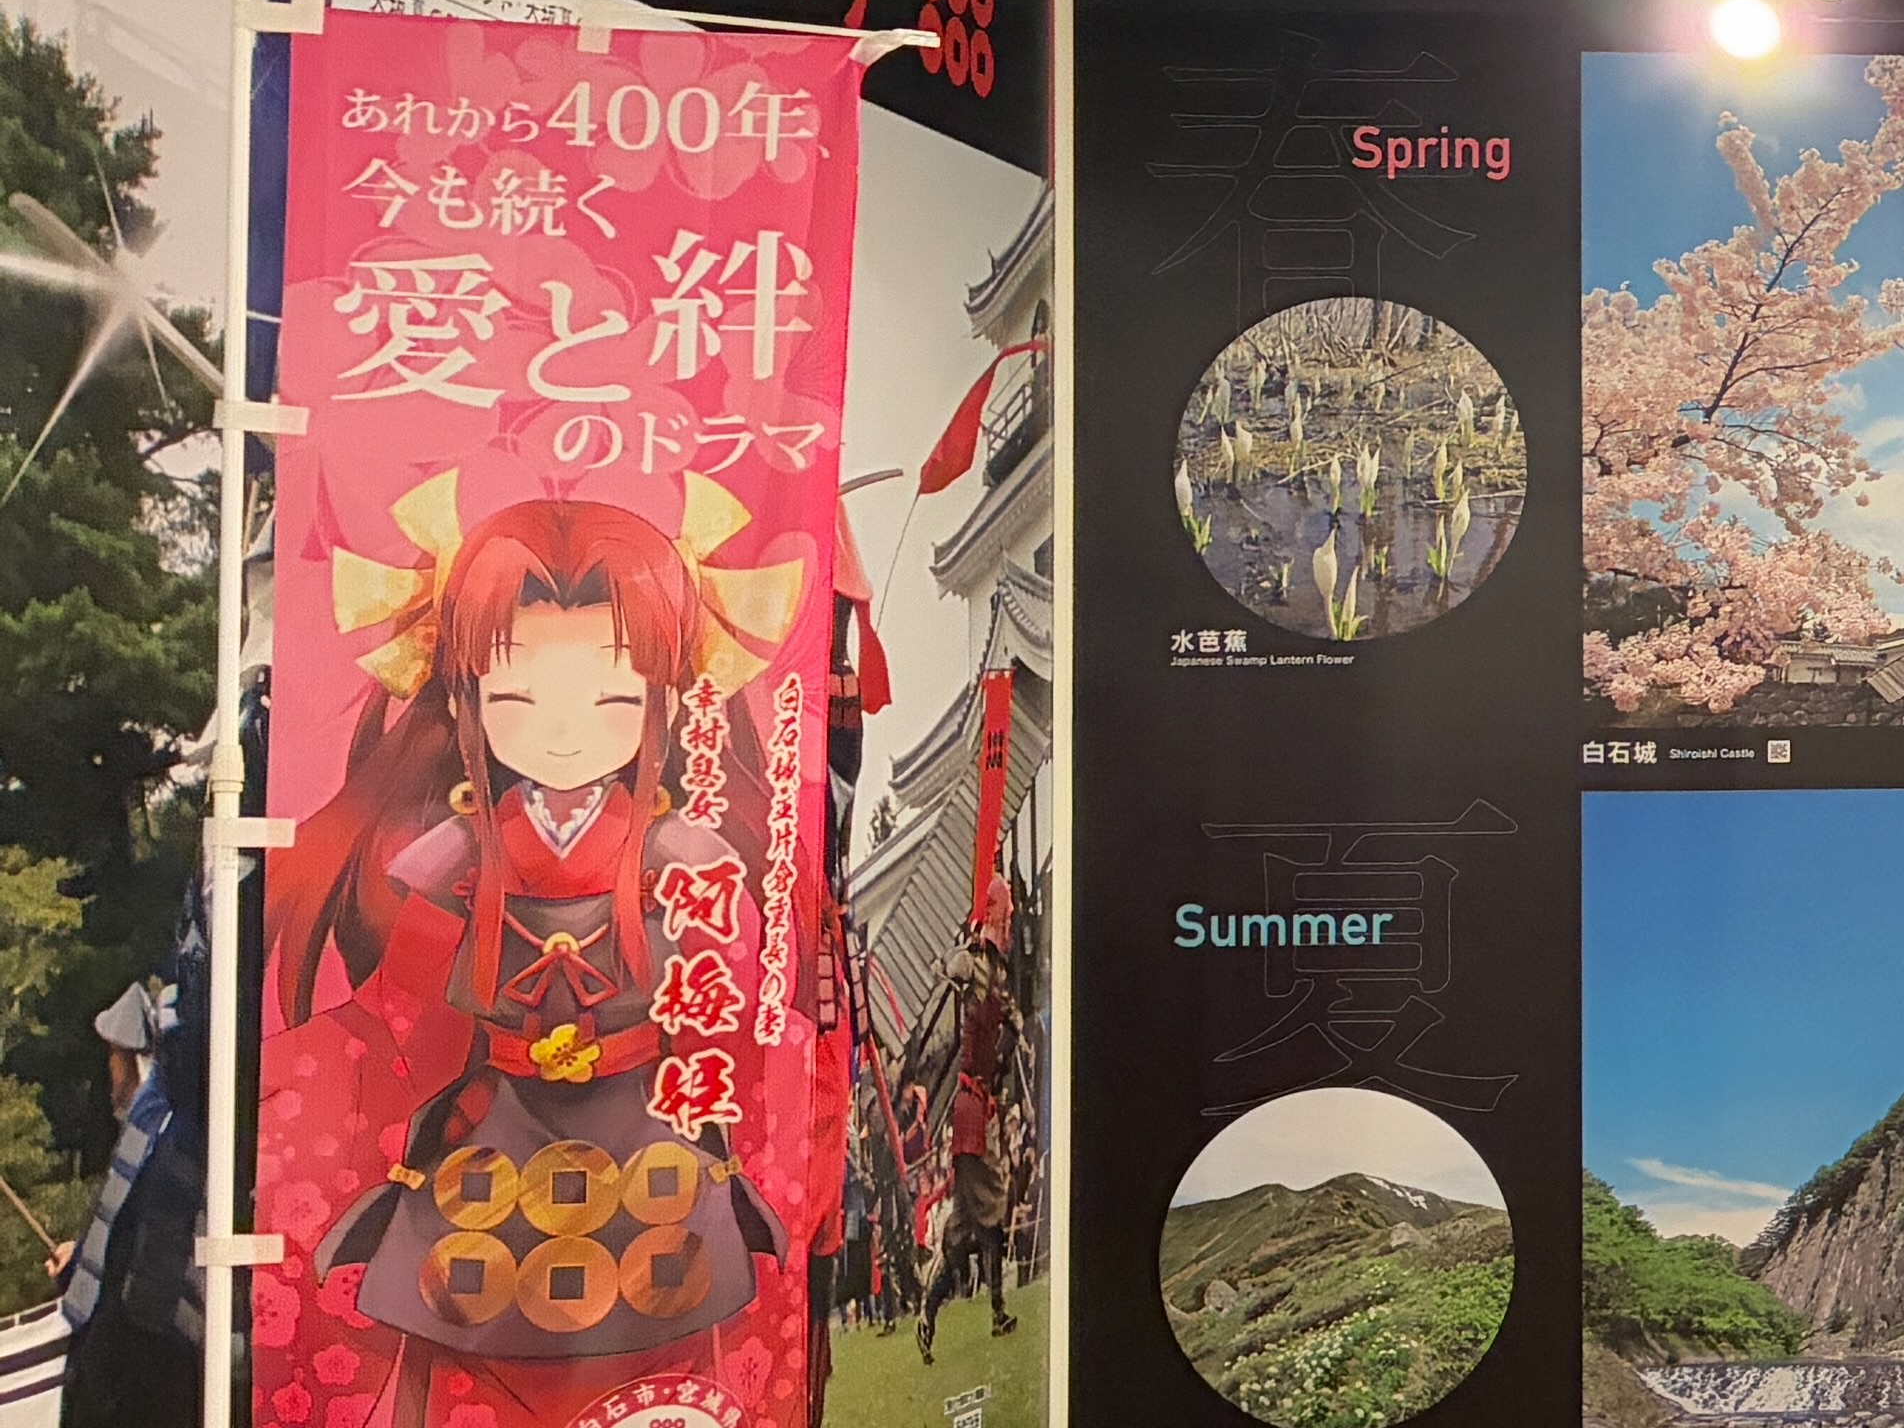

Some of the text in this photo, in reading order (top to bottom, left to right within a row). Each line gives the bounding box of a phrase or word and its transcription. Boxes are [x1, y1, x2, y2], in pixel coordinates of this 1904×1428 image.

[1352, 125, 1511, 180] Spring
[342, 158, 617, 239] 今も続く
[332, 228, 814, 410] 愛と絆
[553, 412, 825, 475] のドラマ
[1170, 654, 1354, 668] Japanese Swamp Lantern Flower
[1171, 629, 1247, 653] 水芭蕉
[682, 673, 727, 828] 幸村息女
[1583, 740, 1657, 764] 白石城
[1669, 748, 1755, 760] Shiroishi Castle
[1174, 904, 1393, 948] Summer
